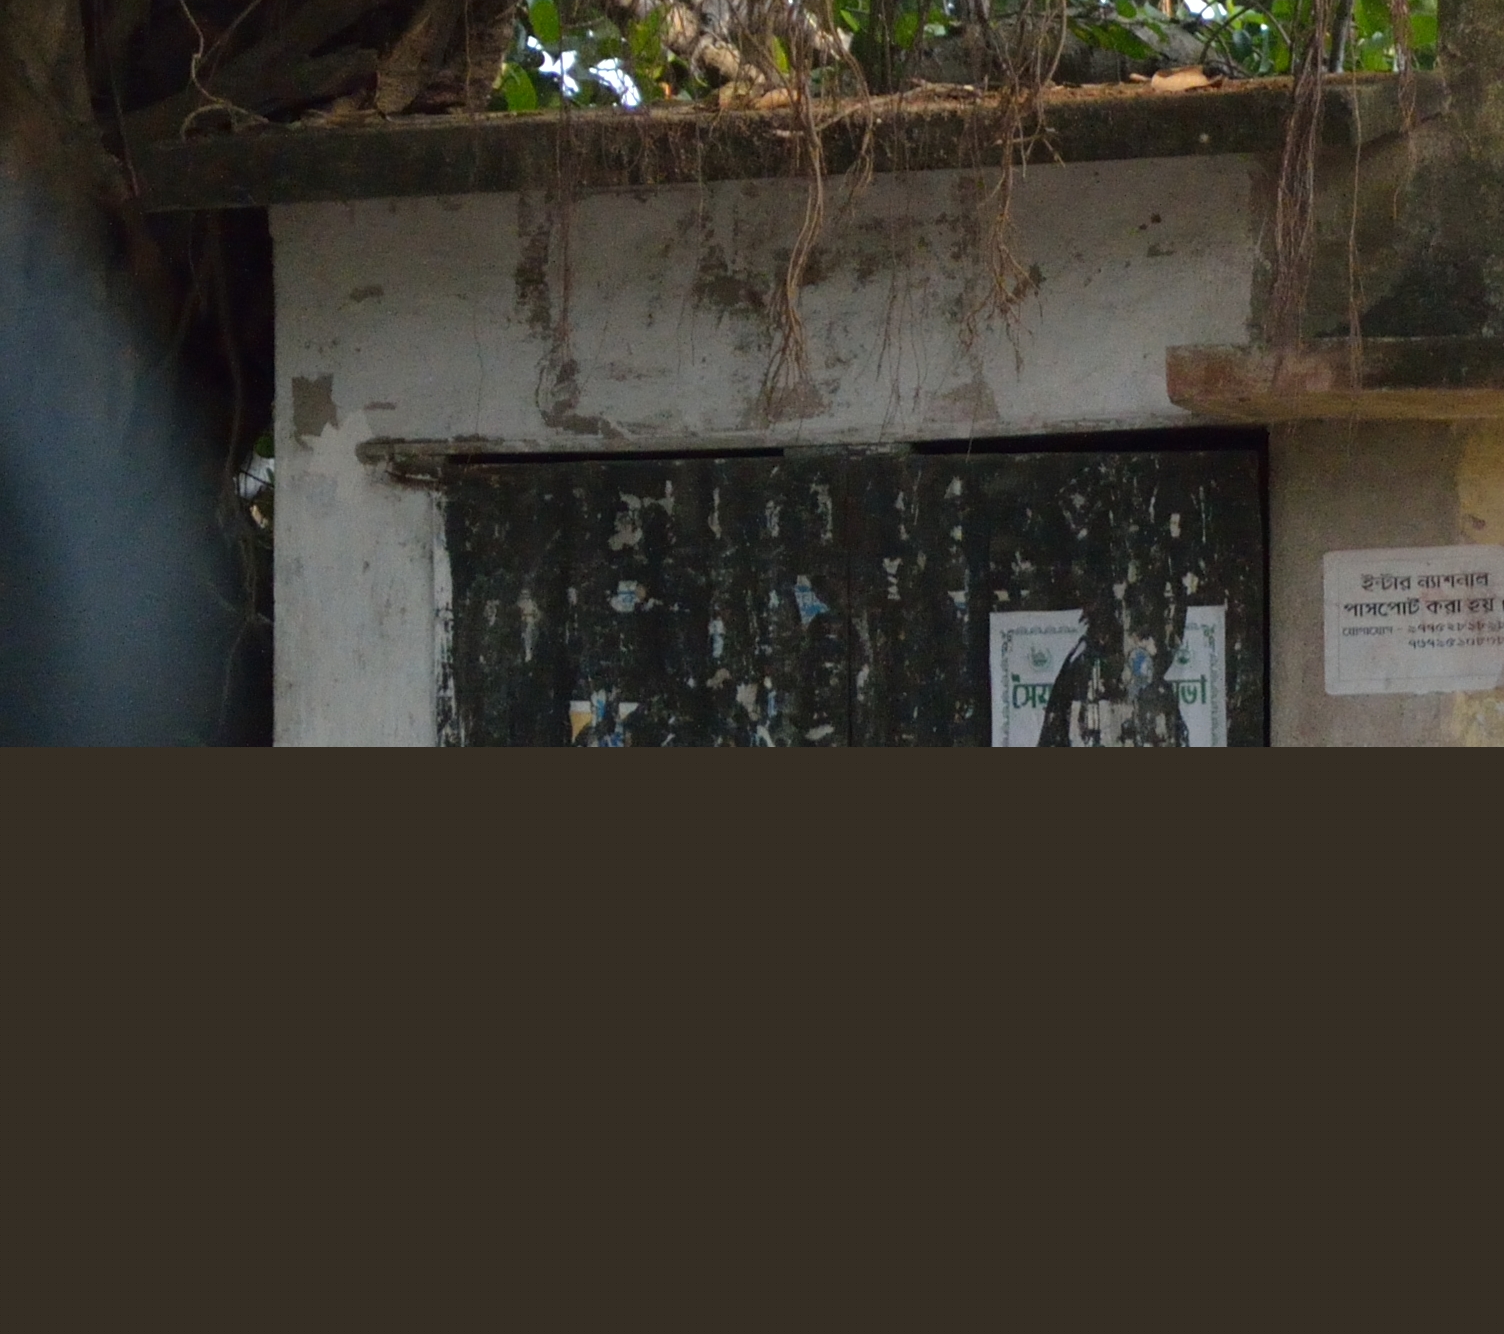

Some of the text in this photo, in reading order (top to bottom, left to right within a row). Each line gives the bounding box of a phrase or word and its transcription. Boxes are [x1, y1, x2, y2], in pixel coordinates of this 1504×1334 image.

[1417, 571, 1489, 590] ন্যাশনাল
[1426, 598, 1462, 615] করা
[1468, 597, 1495, 614] হয়
